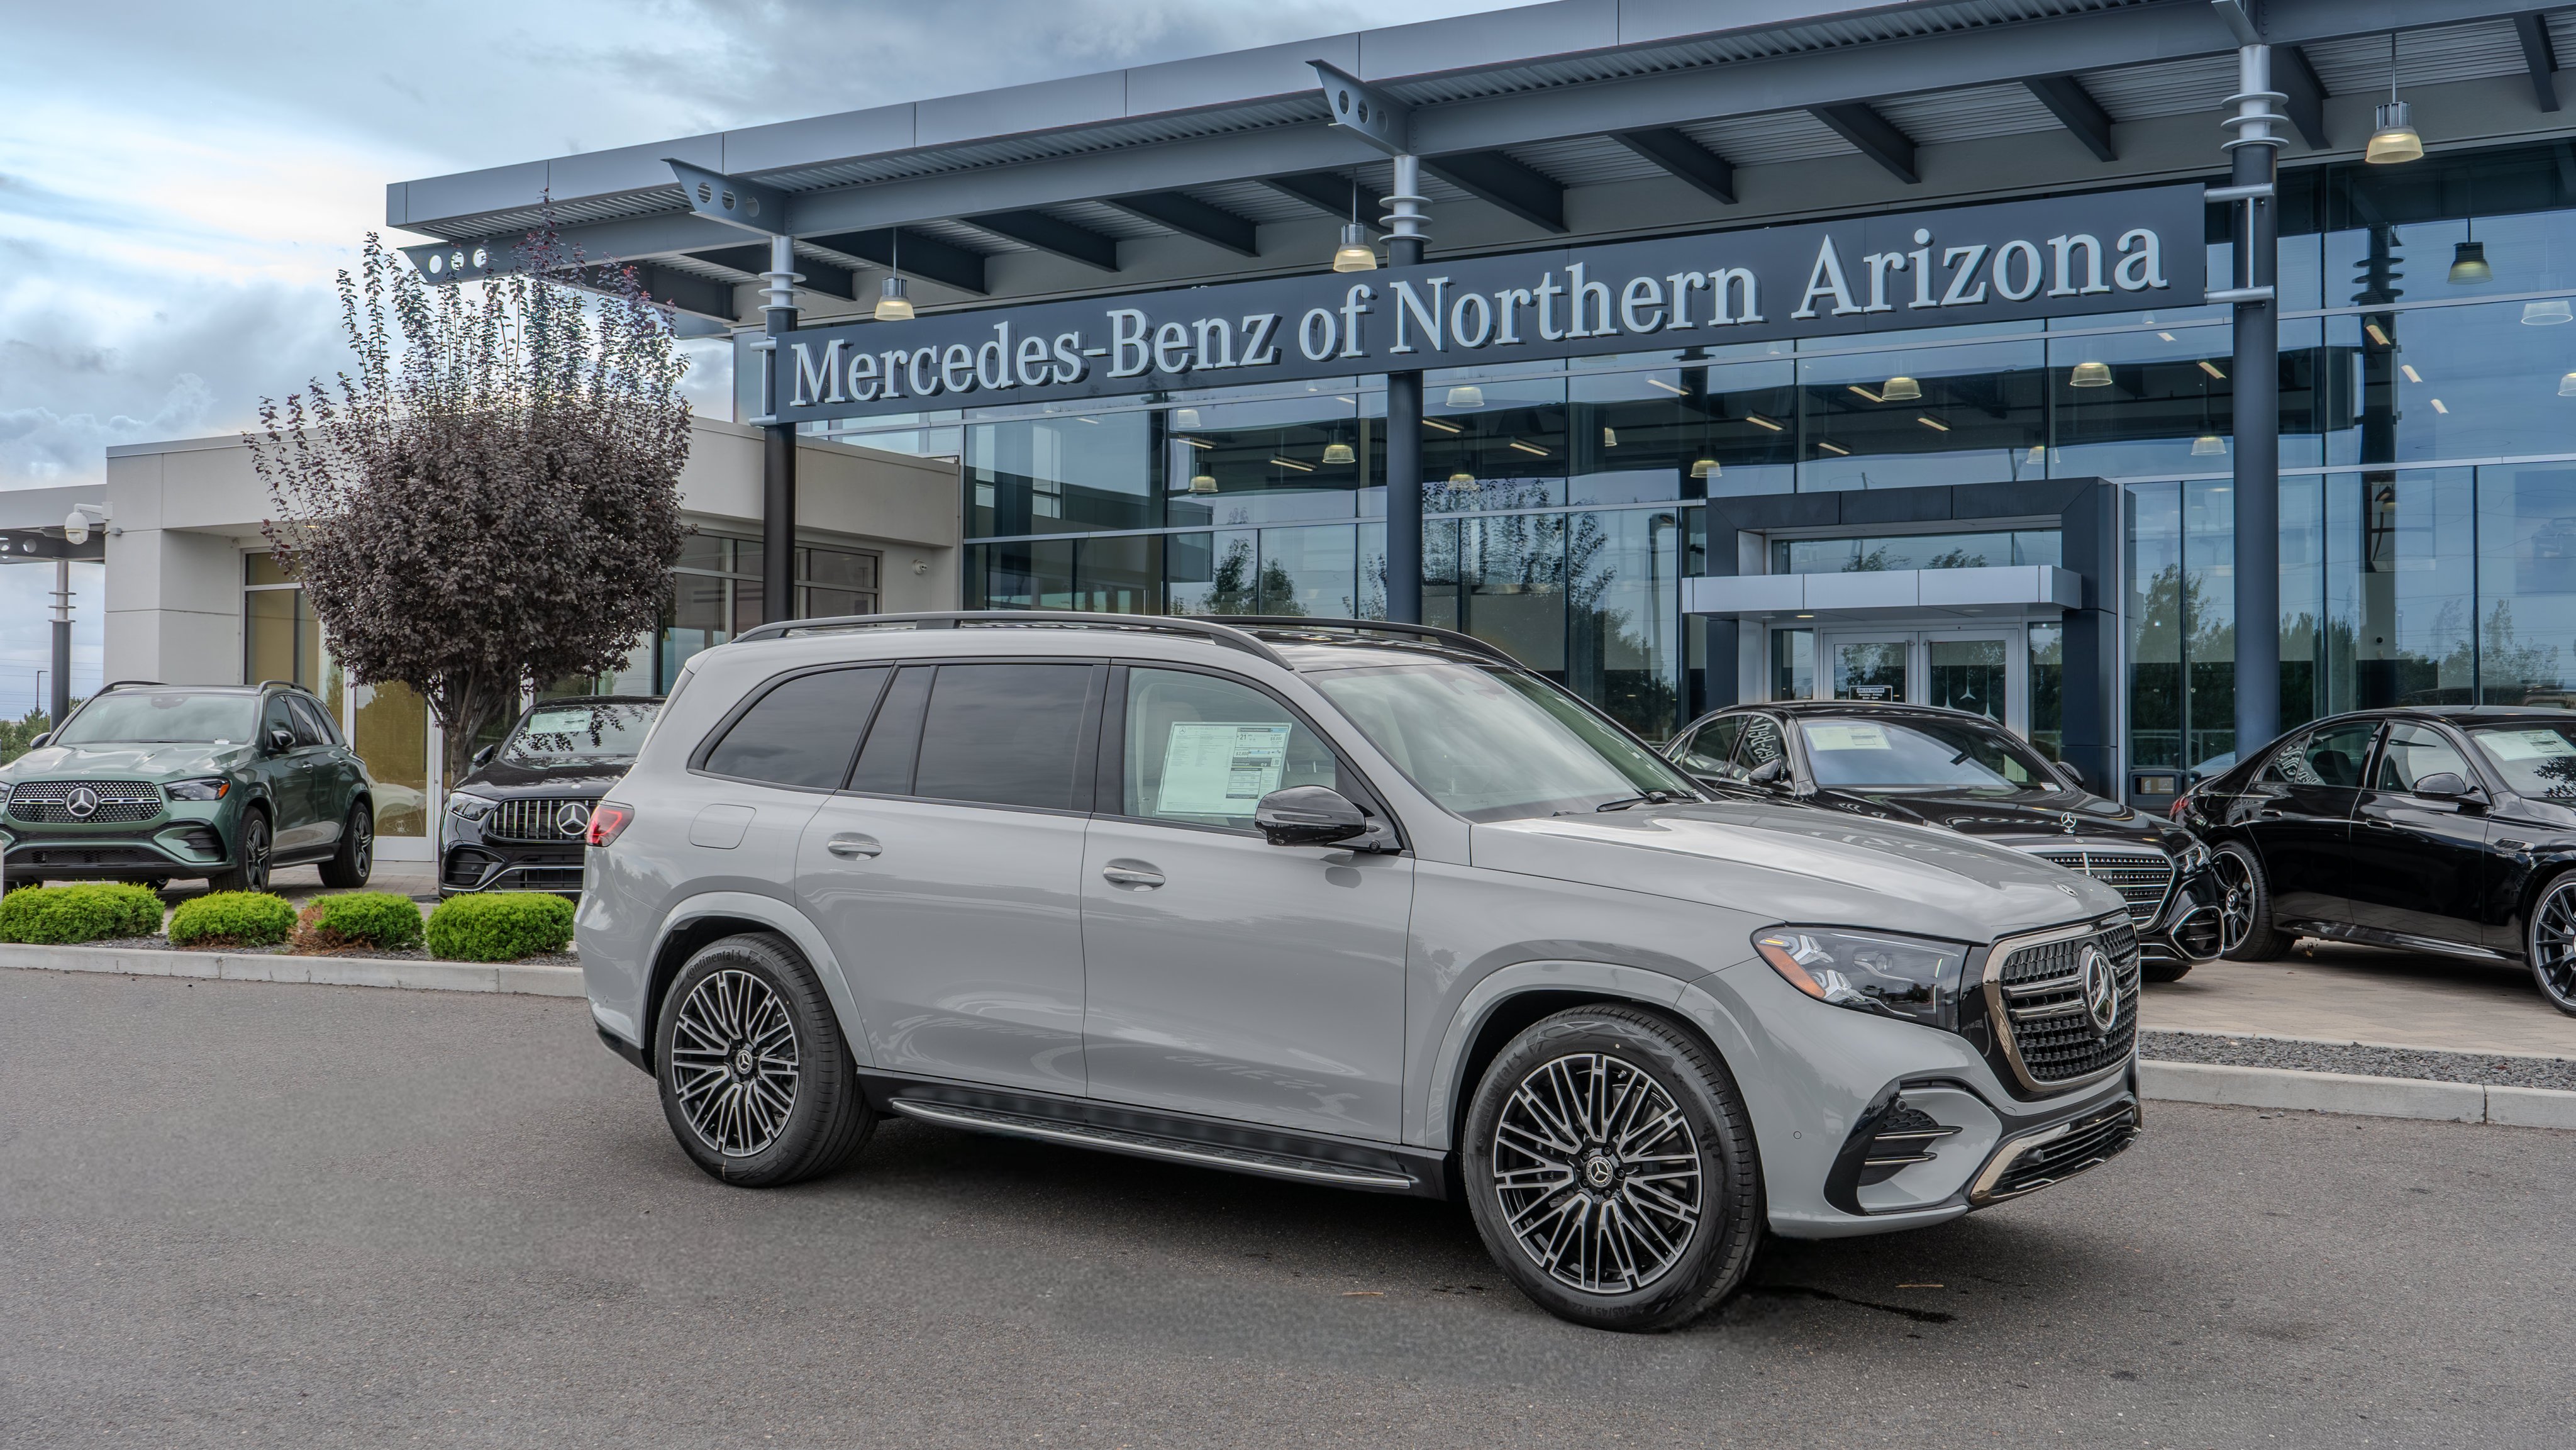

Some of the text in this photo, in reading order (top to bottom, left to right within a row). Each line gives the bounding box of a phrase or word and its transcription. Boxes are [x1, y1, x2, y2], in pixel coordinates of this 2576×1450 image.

[789, 228, 2167, 406] Mercedes-Benz of Northern Arizona
[687, 949, 735, 979] Continental
